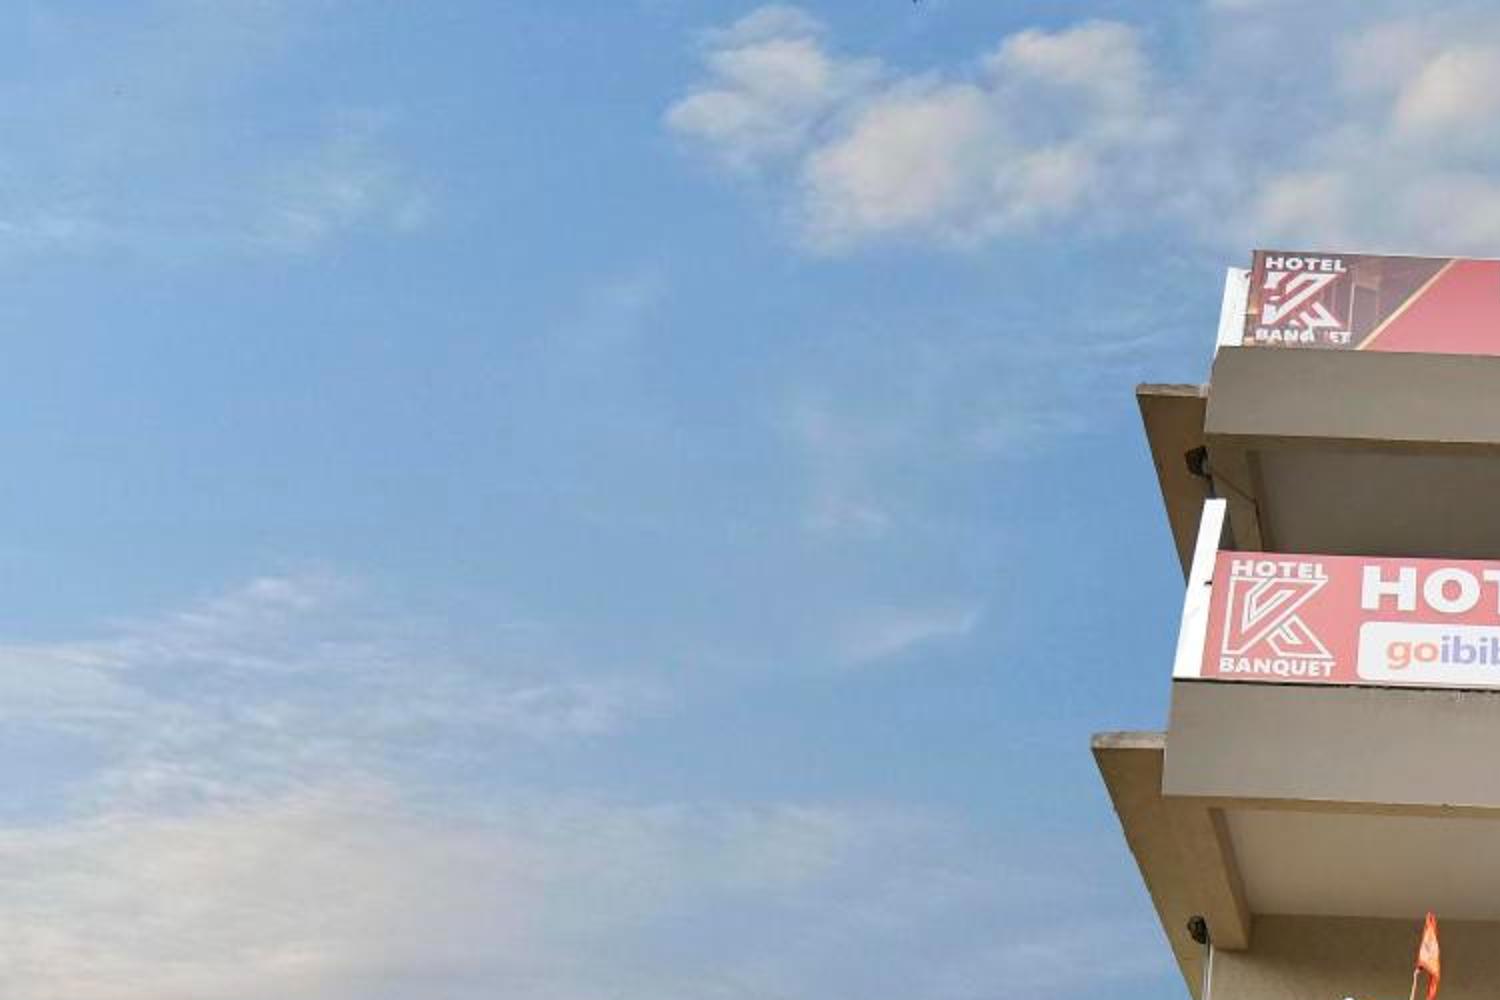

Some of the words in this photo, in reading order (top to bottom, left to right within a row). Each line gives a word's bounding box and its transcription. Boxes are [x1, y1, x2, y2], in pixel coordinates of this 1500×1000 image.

[1265, 256, 1347, 272] HOTEL
[1255, 327, 1352, 344] BANQET
[1231, 559, 1328, 579] HOTEL
[1220, 657, 1336, 676] BANQUET
